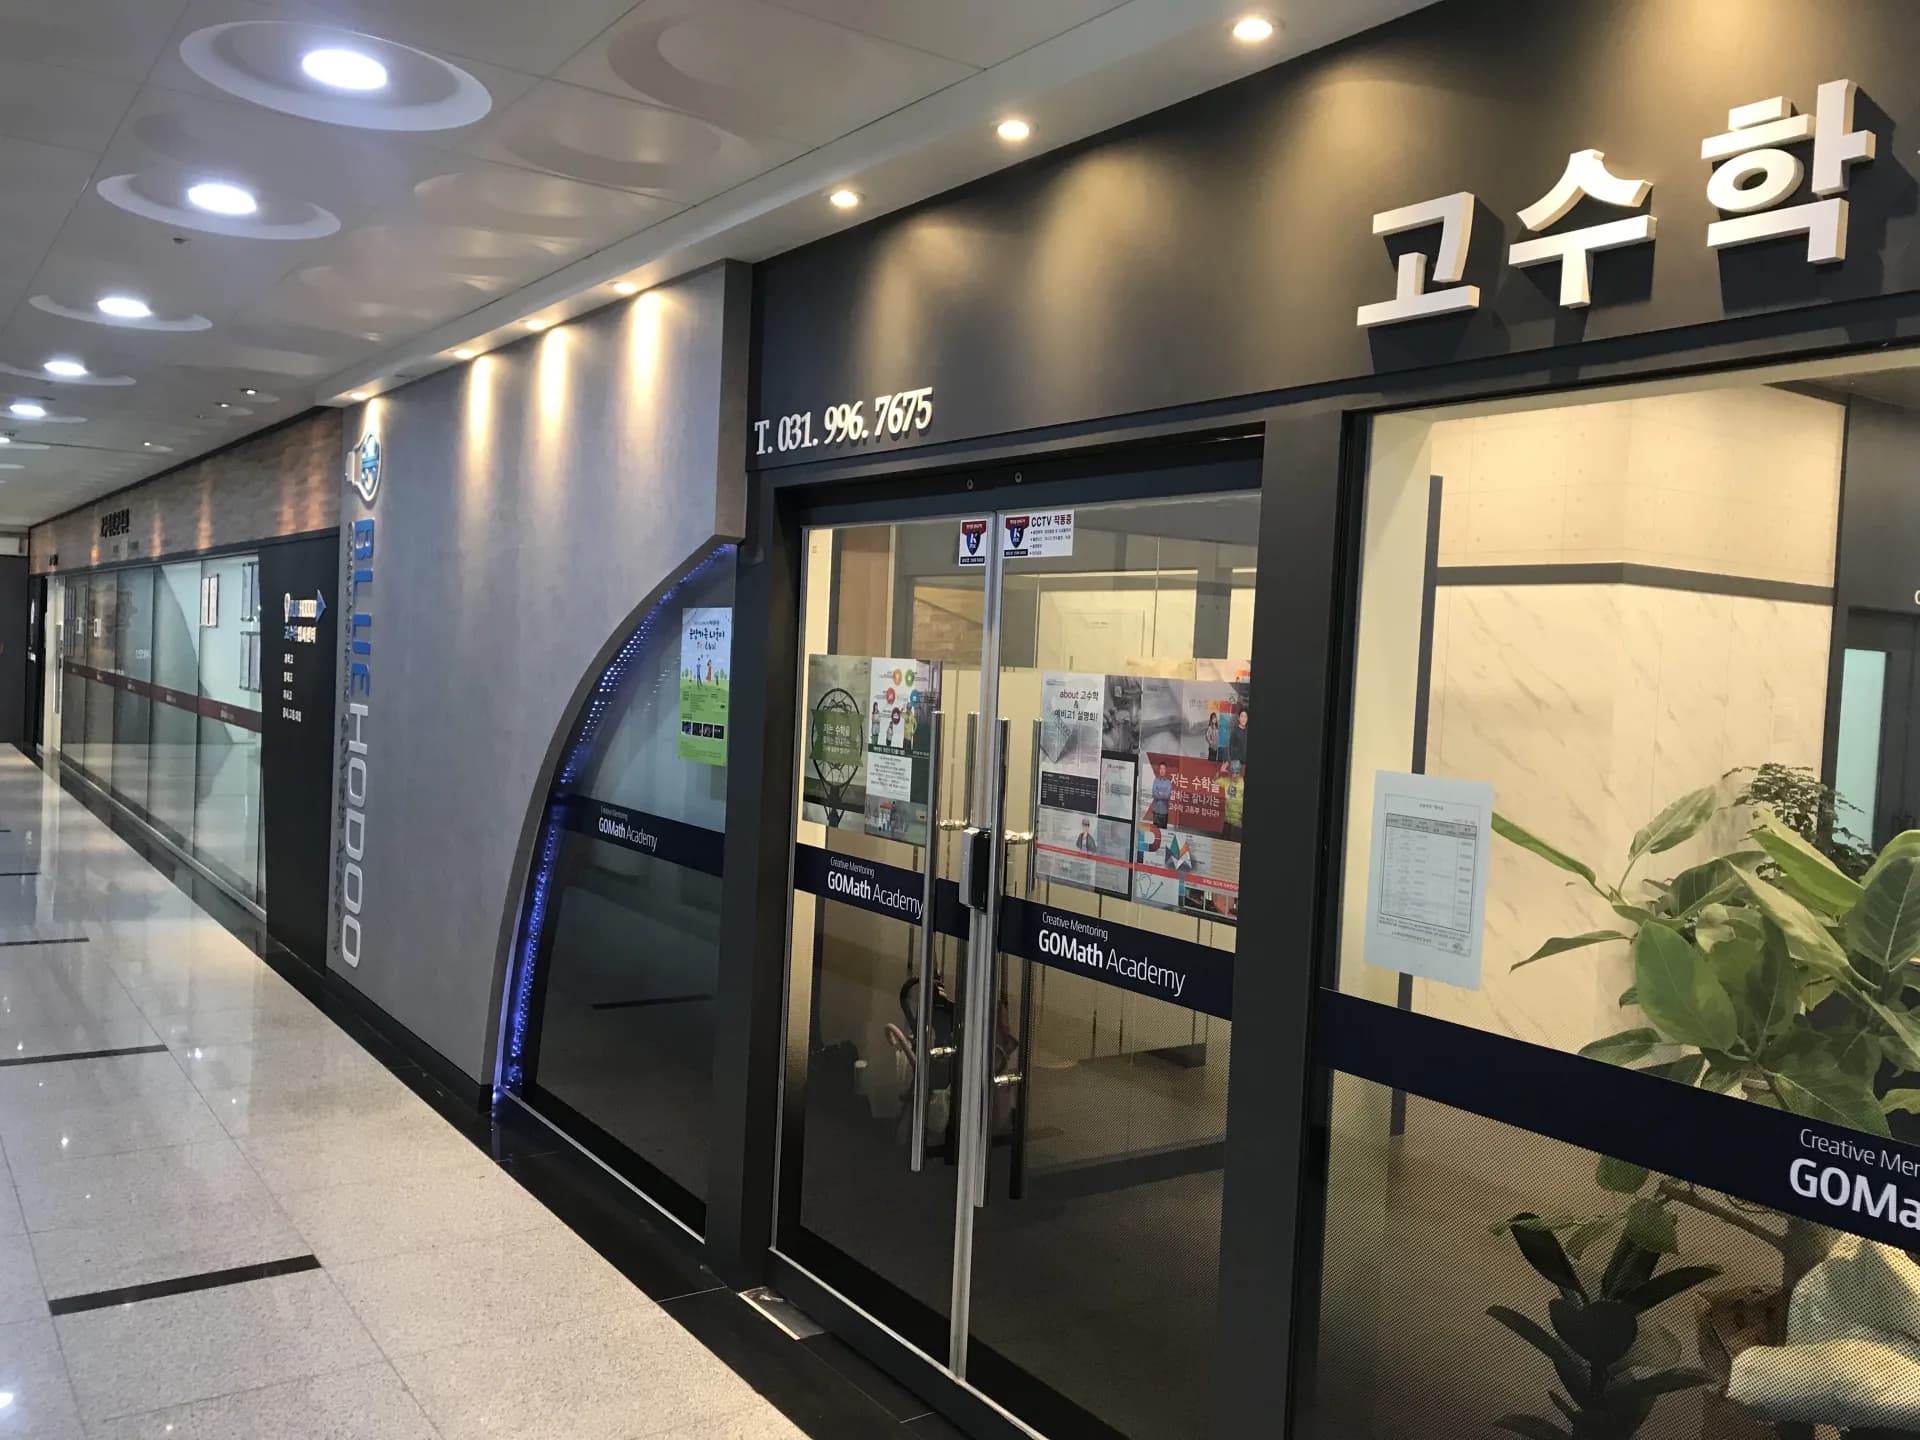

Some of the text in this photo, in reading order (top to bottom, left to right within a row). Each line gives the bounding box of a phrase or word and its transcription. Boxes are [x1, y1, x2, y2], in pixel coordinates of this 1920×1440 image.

[1357, 79, 1876, 328] 고수학
[754, 386, 933, 455] T. 031. 996. 7675
[1031, 516, 1052, 528] CCTV
[1054, 513, 1072, 526] 작동중
[1059, 689, 1099, 701] about 고수학
[1170, 773, 1220, 793] 저는 수학을
[598, 816, 658, 853] GOMath Academy
[830, 856, 875, 879] Creative Mentoring
[827, 870, 924, 920] GOMath Academy
[1042, 911, 1109, 942] Creative Mentoring
[1038, 929, 1186, 998] GOMath Academy
[1800, 1128, 1876, 1166] Creative
